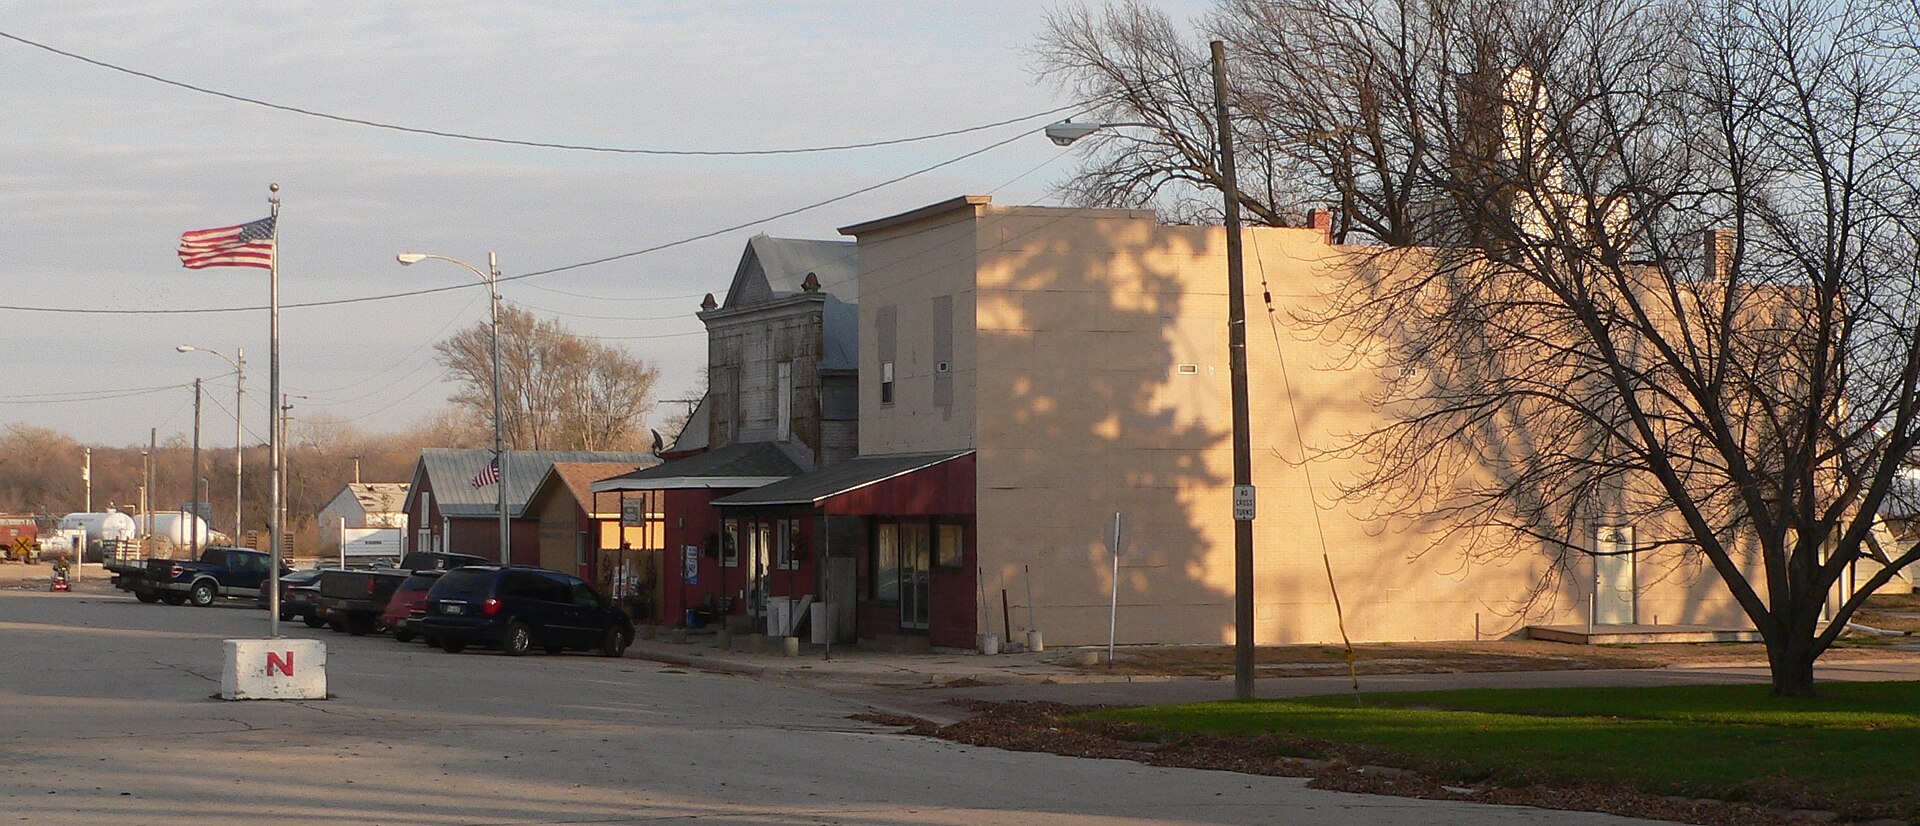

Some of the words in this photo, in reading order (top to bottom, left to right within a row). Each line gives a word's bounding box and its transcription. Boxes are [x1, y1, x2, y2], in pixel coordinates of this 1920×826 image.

[1241, 489, 1248, 497] NO
[1236, 508, 1252, 516] TURNS
[266, 651, 294, 677] N
